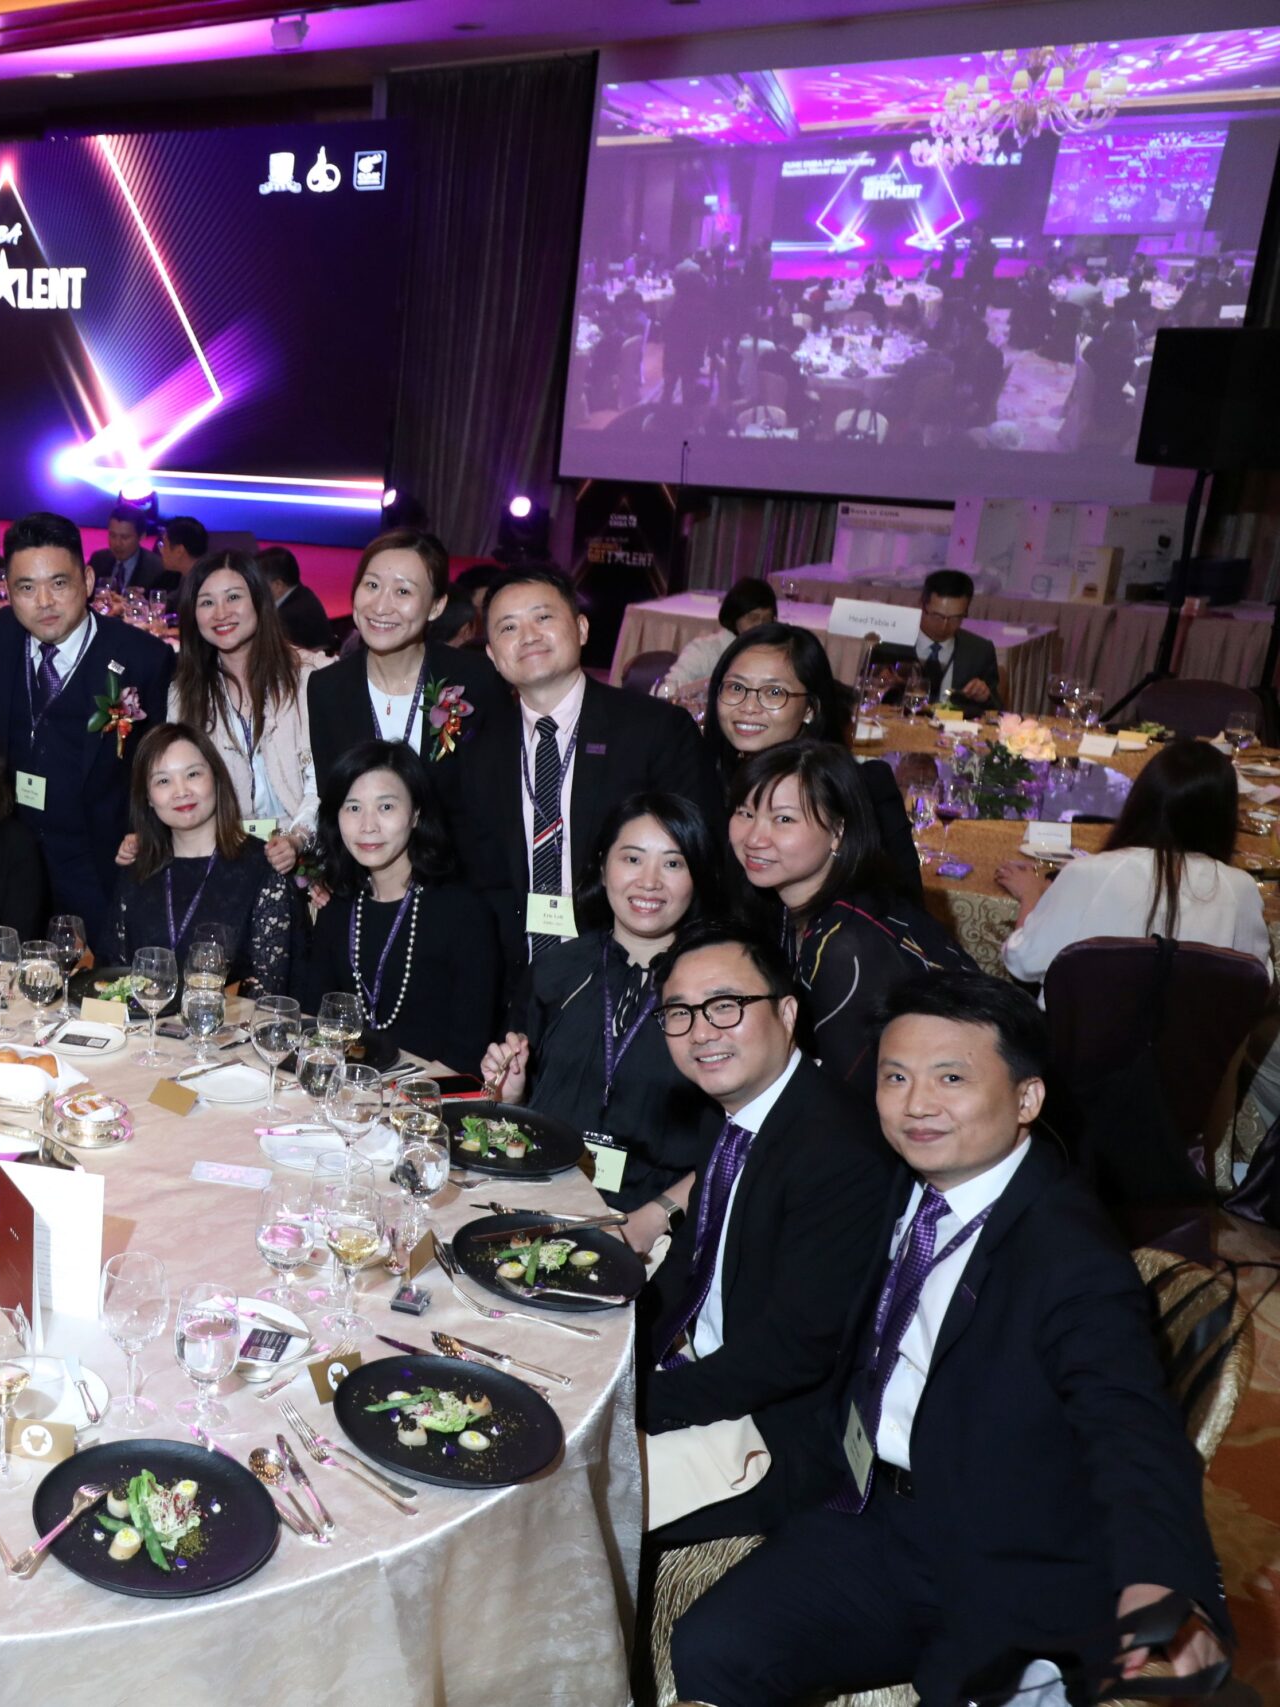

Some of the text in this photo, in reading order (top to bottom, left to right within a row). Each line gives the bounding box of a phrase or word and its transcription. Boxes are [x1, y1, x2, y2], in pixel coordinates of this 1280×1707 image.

[848, 614, 897, 628] Head Table 4
